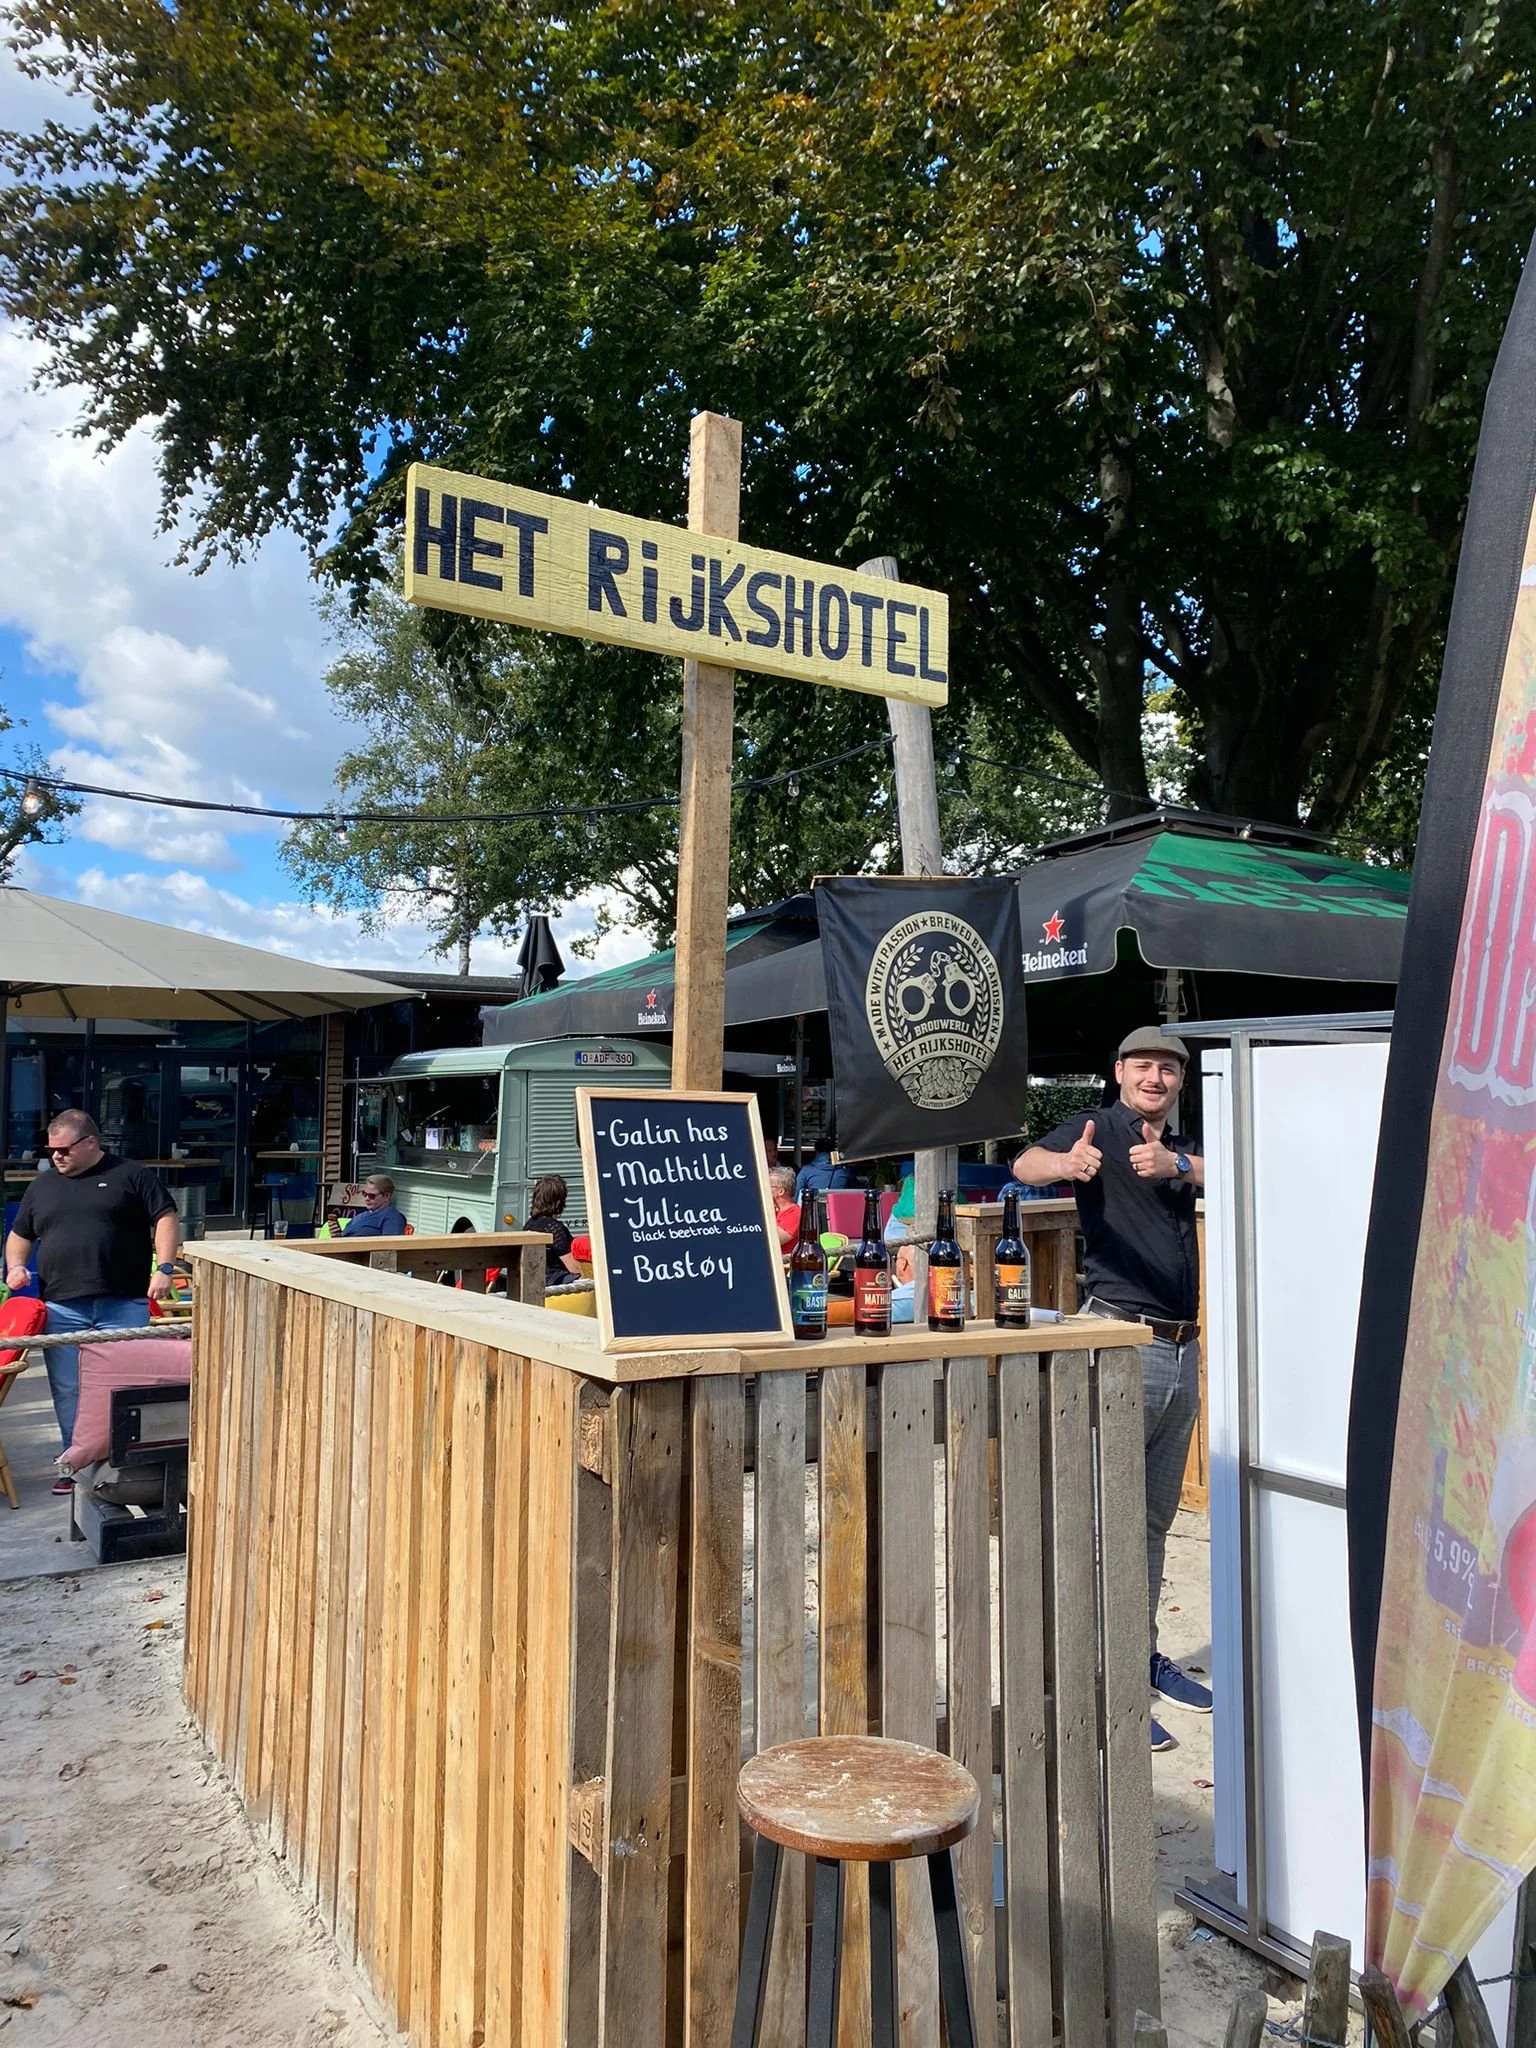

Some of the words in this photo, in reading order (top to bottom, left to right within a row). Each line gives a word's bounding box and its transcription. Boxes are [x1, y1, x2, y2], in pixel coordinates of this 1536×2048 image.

[414, 488, 548, 597] HET
[880, 919, 921, 959] PASSION
[929, 915, 972, 941] BREWED
[971, 938, 984, 954] BY
[1022, 947, 1087, 973] Heineken
[871, 960, 887, 995] WITH
[981, 954, 1001, 1035] BEARDSMEN
[638, 1011, 667, 1025] Heineken
[871, 1000, 887, 1039] MADE
[913, 1018, 970, 1037] BROUWERIJ
[892, 1046, 916, 1072] HET
[919, 1037, 988, 1065] RIJKSHOTEL
[609, 1118, 680, 1147] Galin
[686, 1117, 729, 1143] has
[615, 1152, 747, 1187] Mathilde
[623, 1196, 728, 1229] Juliaea
[632, 1229, 667, 1243] Black
[669, 1224, 722, 1239] beetroot
[726, 1223, 762, 1234] saison
[633, 1250, 734, 1290] Bastøy
